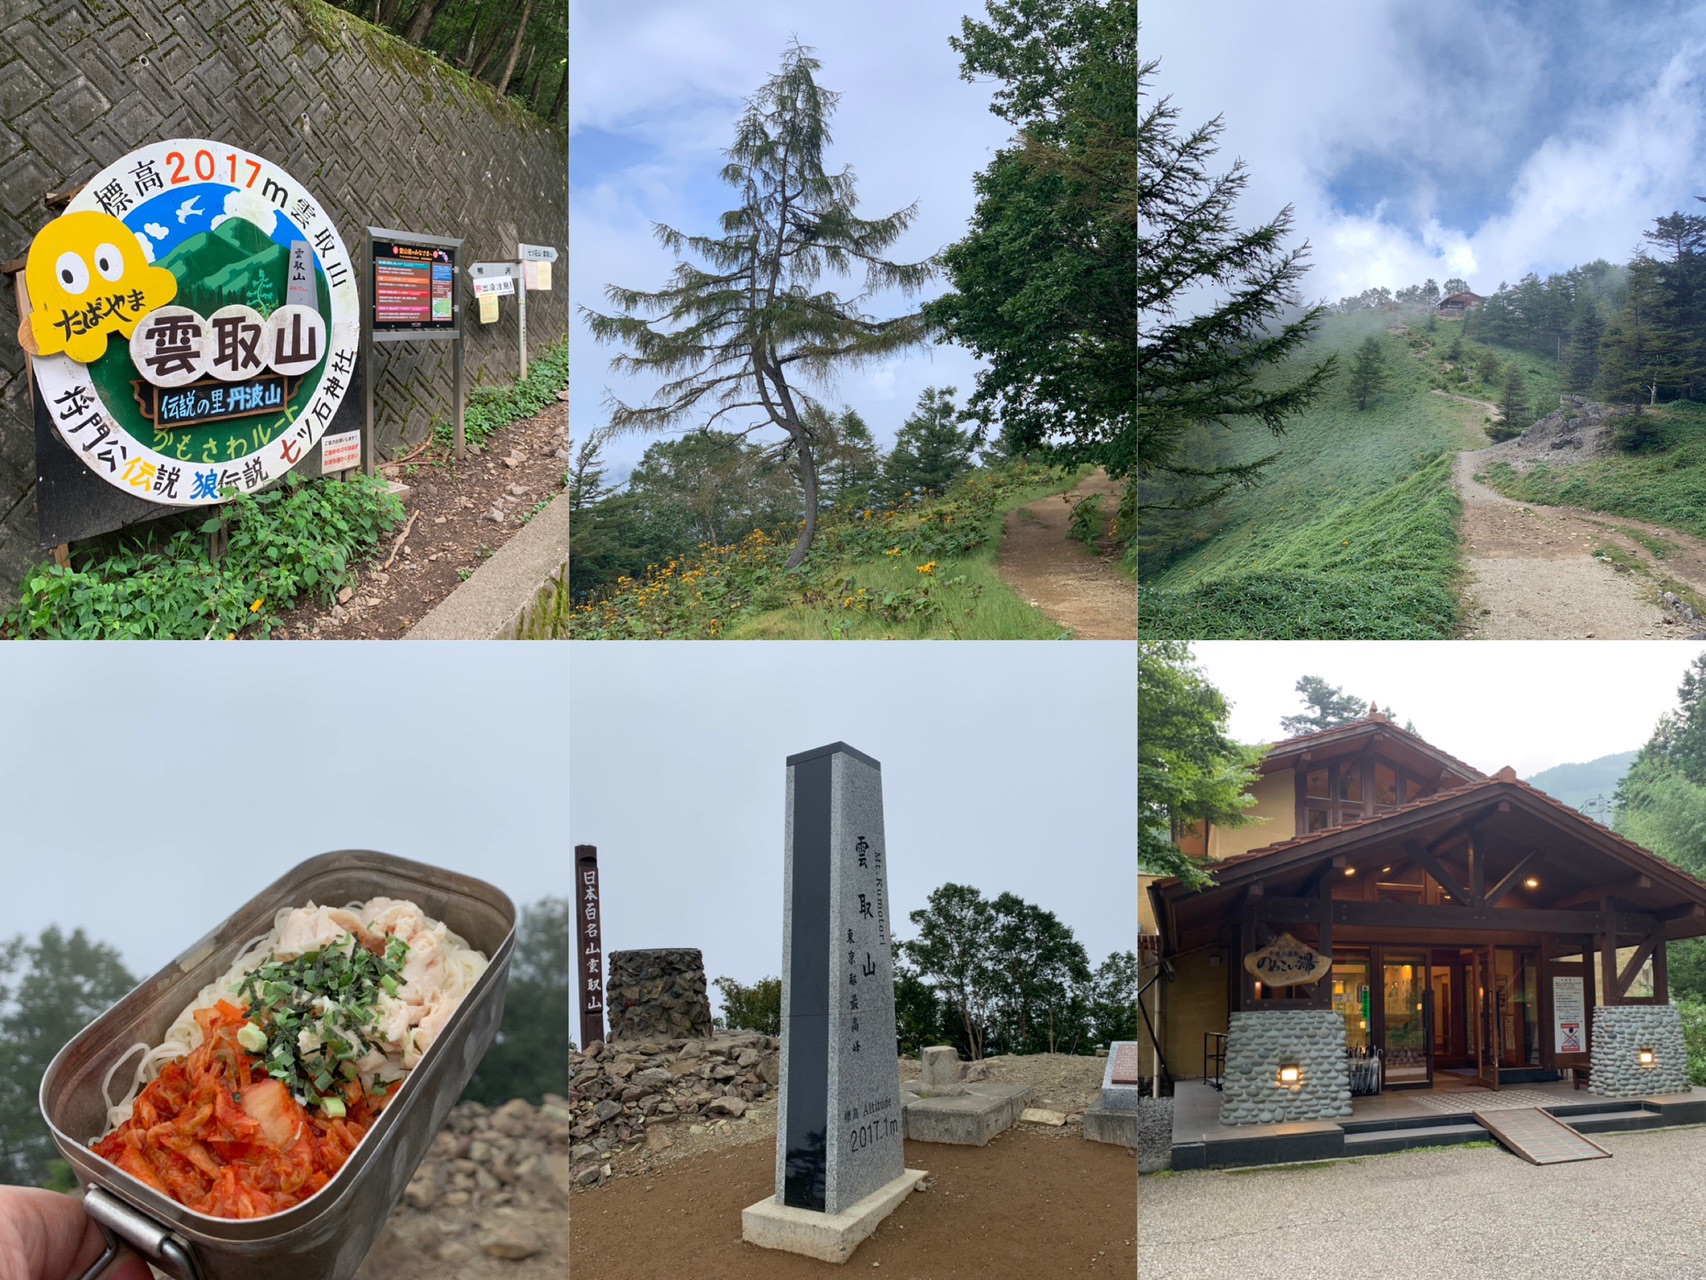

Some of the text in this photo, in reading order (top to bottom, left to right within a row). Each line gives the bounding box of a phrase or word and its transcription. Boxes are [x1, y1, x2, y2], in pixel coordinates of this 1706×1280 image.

[290, 198, 348, 289] 雲取山
[293, 247, 305, 281] 雲取山
[53, 289, 147, 342] たばやま
[145, 313, 317, 377] 雲取山
[152, 405, 299, 464] かもさわルート
[279, 349, 354, 464] 七ツ石神社
[191, 456, 269, 500] 狼伝説
[855, 836, 876, 977] 雲取山
[850, 1117, 899, 1153] 2017.1m
